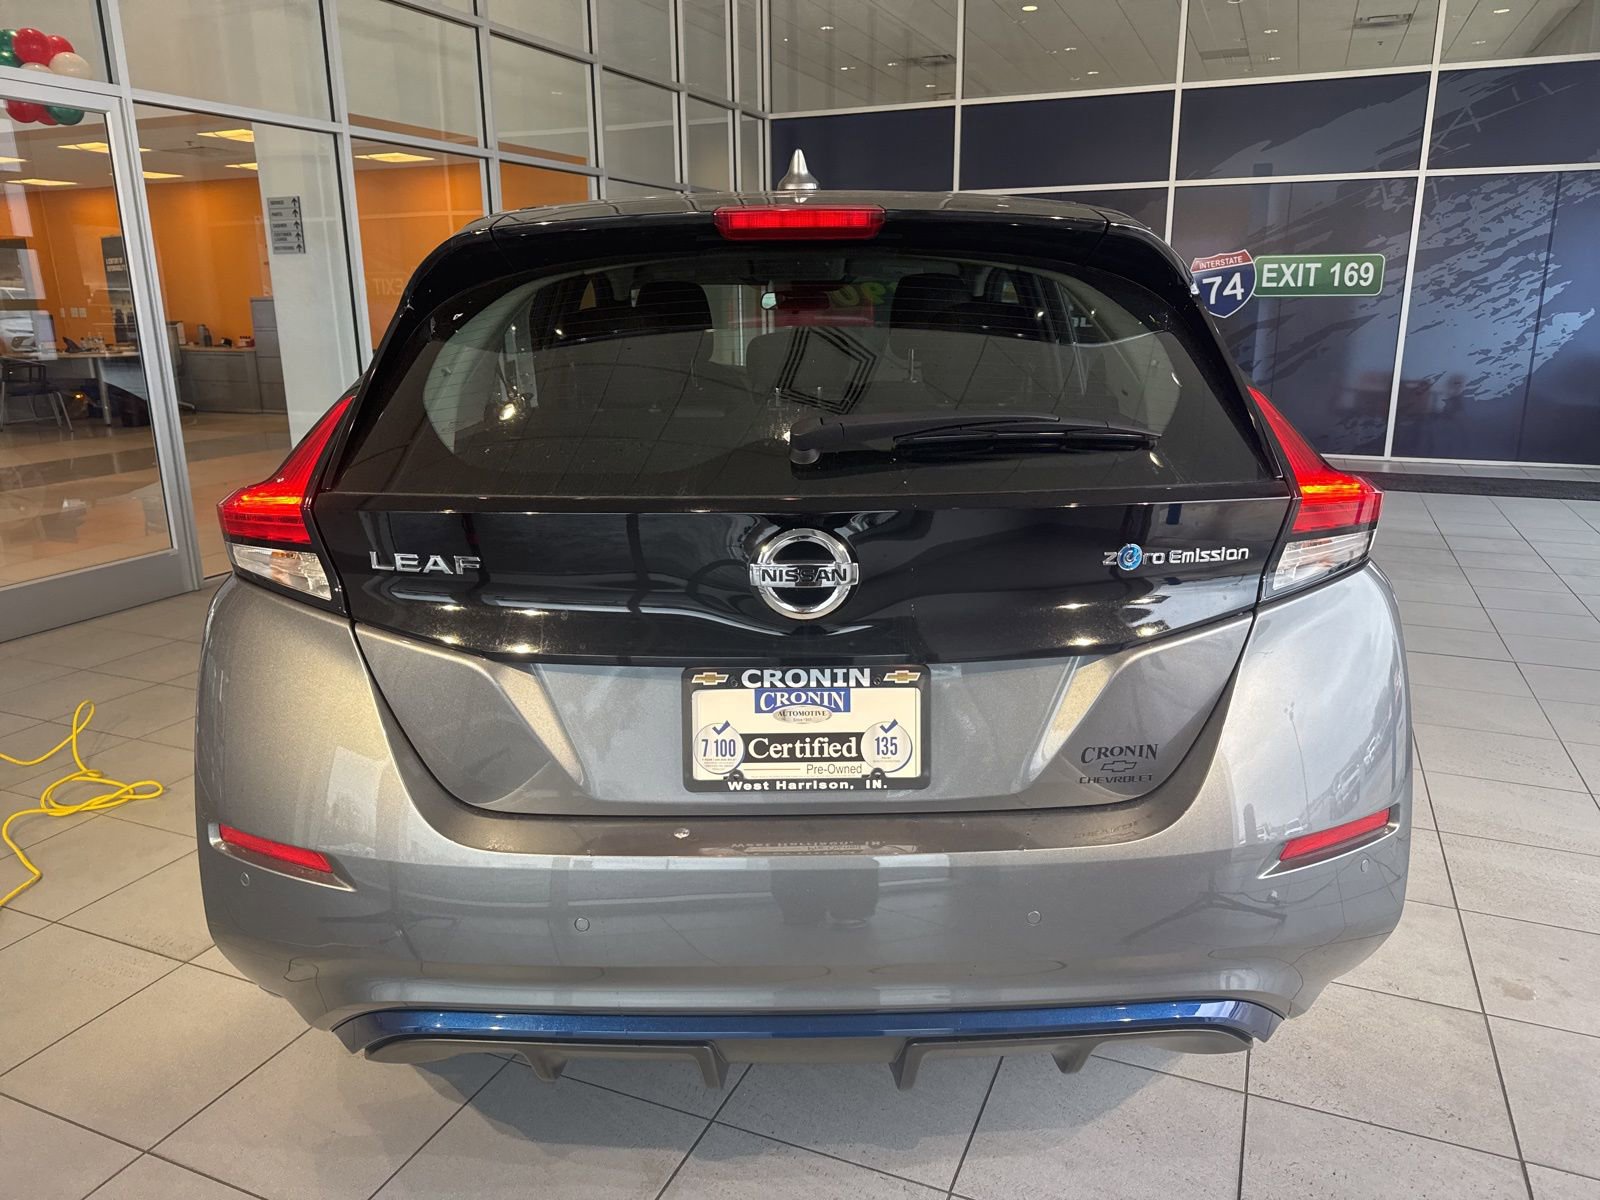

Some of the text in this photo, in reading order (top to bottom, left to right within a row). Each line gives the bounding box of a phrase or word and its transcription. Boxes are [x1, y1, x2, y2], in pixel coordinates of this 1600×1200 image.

[1199, 255, 1243, 269] INTERSTATE
[1261, 262, 1375, 288] EXIT 169
[1202, 272, 1245, 305] 74
[369, 551, 481, 575] LEAF
[1169, 547, 1249, 564] Emission
[761, 568, 847, 582] NISSAN
[741, 668, 871, 688] CRONIN
[760, 691, 846, 712] CRONIN
[714, 738, 736, 757] 100
[748, 737, 858, 759] Certified
[874, 736, 898, 756] 135
[1080, 743, 1159, 764] CRONIN
[806, 763, 863, 775] Pre-Owned
[727, 779, 888, 791] West Harrison, IN.
[1079, 775, 1153, 784] CHEVROLET
